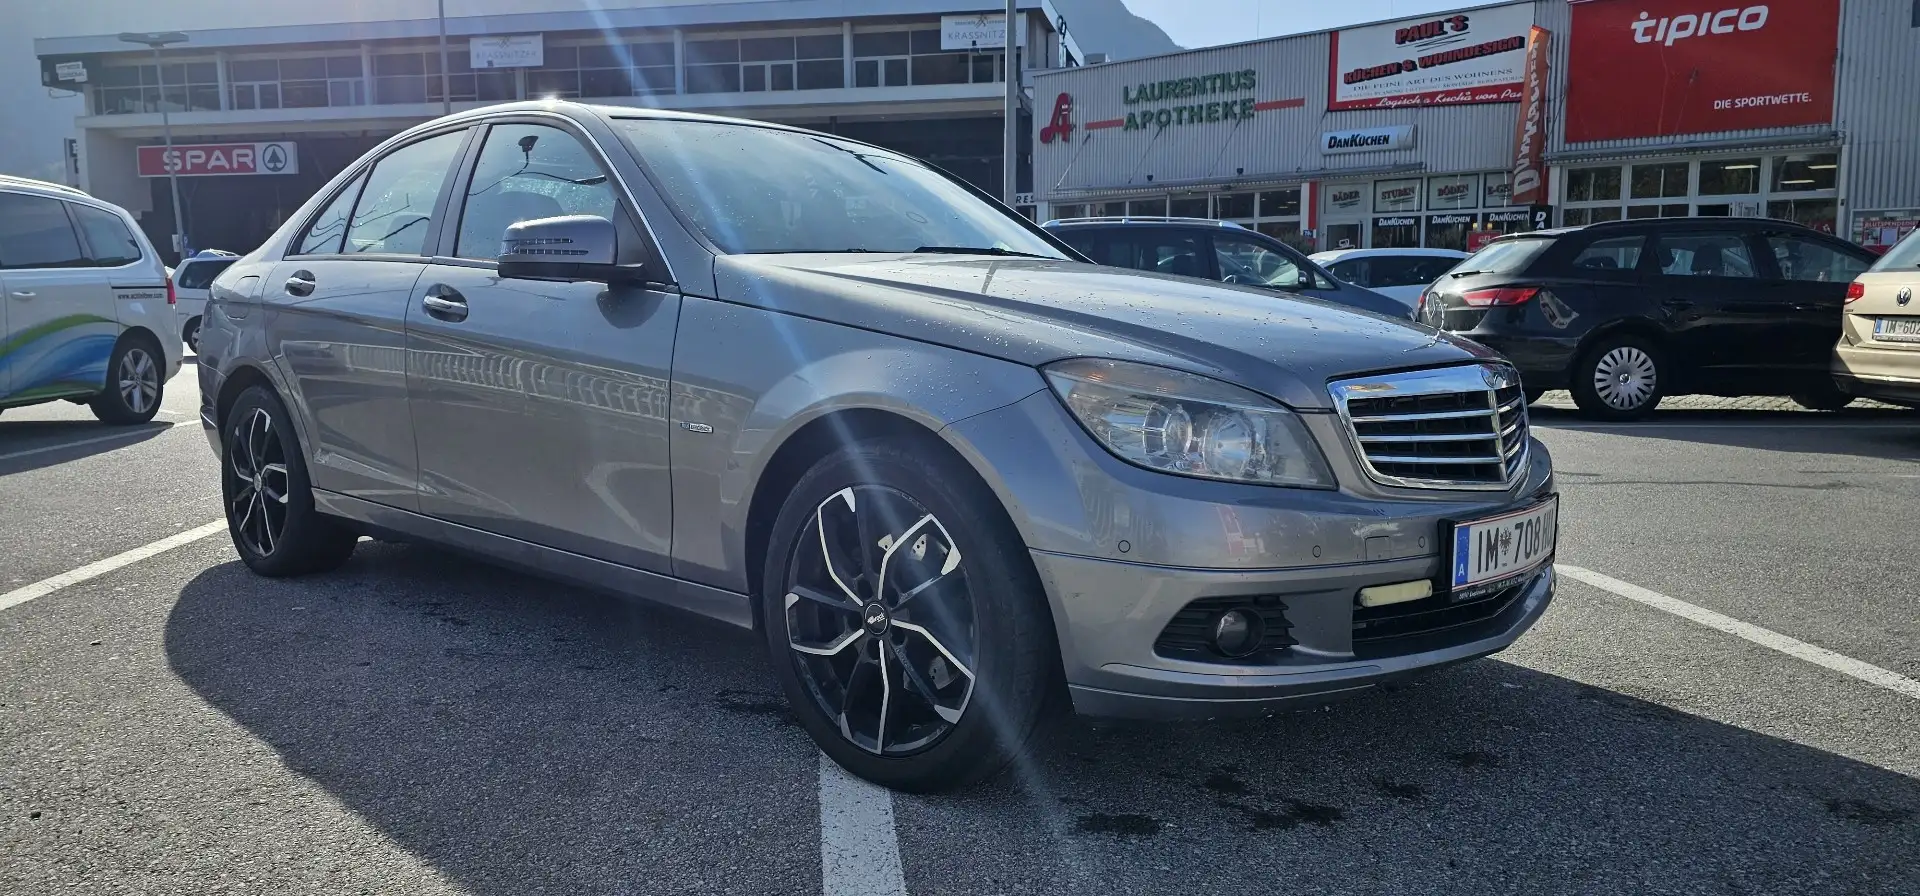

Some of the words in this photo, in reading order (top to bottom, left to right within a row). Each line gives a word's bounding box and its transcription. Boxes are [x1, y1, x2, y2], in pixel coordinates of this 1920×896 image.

[1395, 15, 1469, 45] PAUL'S
[1631, 5, 1769, 46] tipico
[1455, 68, 1513, 80] WOHNENS
[1123, 69, 1256, 104] LAURENTIUS
[1714, 100, 1732, 110] DIE
[1735, 92, 1812, 108] SPORTWETTE.
[1123, 98, 1256, 131] APOTHEKE
[163, 149, 254, 171] SPAR
[1332, 191, 1360, 202] BÄDER
[1381, 187, 1415, 200] STUBEN
[1437, 184, 1469, 196] BÖDEN
[1885, 320, 1898, 334] IM
[1477, 527, 1500, 574] IM
[1514, 515, 1541, 564] 708
[1458, 563, 1465, 577] A
